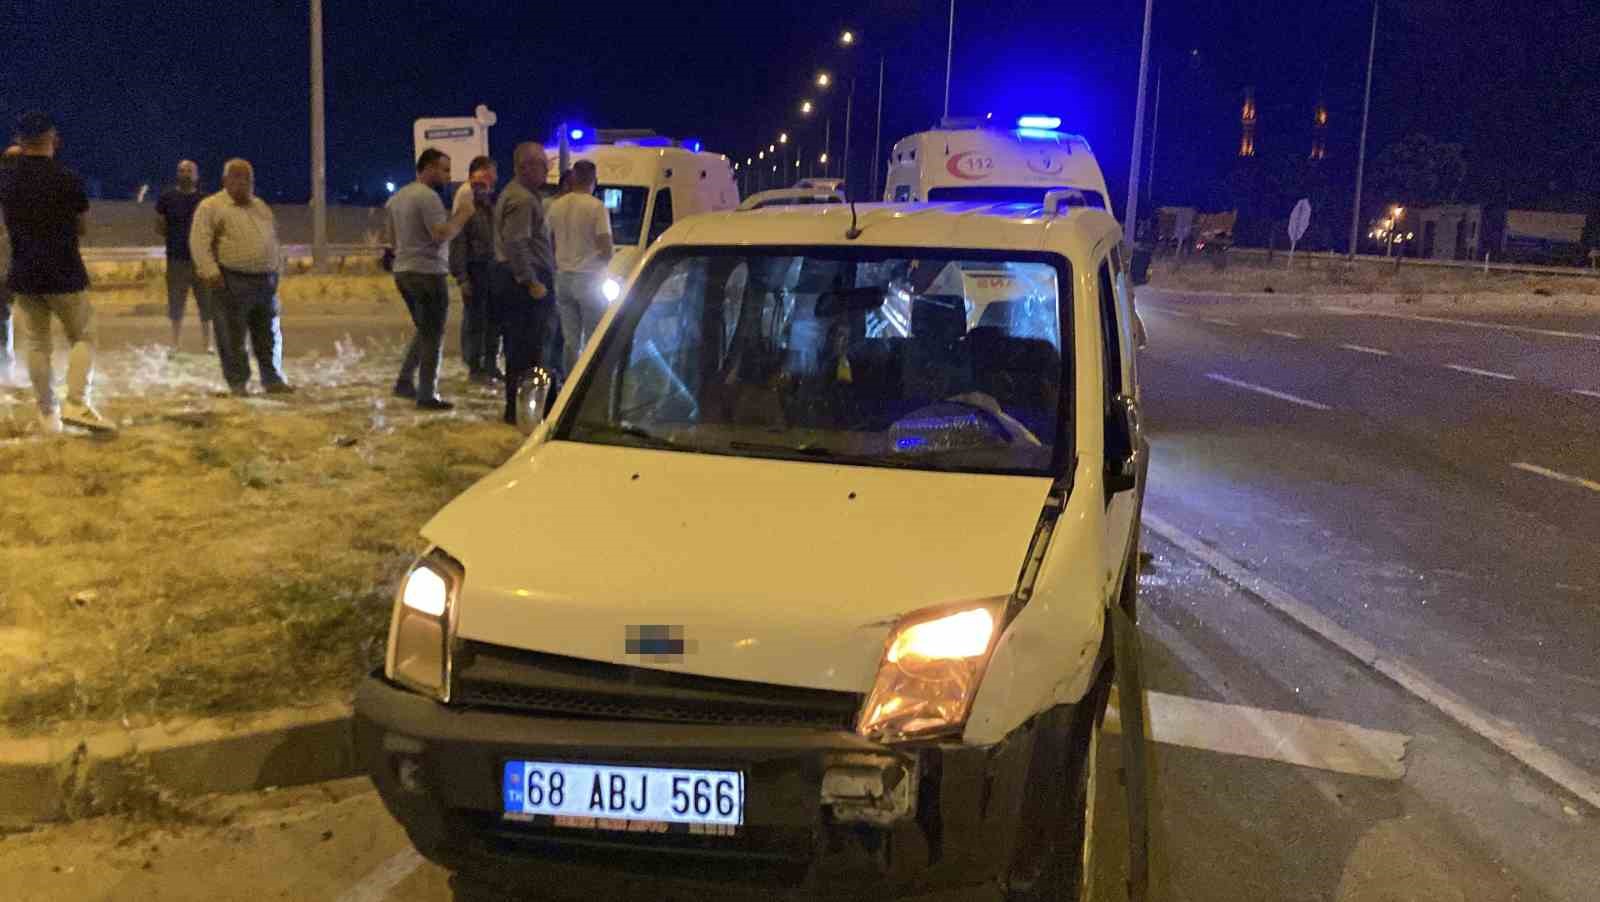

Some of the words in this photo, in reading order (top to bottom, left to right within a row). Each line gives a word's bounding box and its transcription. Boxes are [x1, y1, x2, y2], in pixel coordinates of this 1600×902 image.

[966, 157, 993, 170] 112
[527, 769, 565, 808] 68
[589, 772, 648, 813] ABJ
[671, 776, 734, 817] 566
